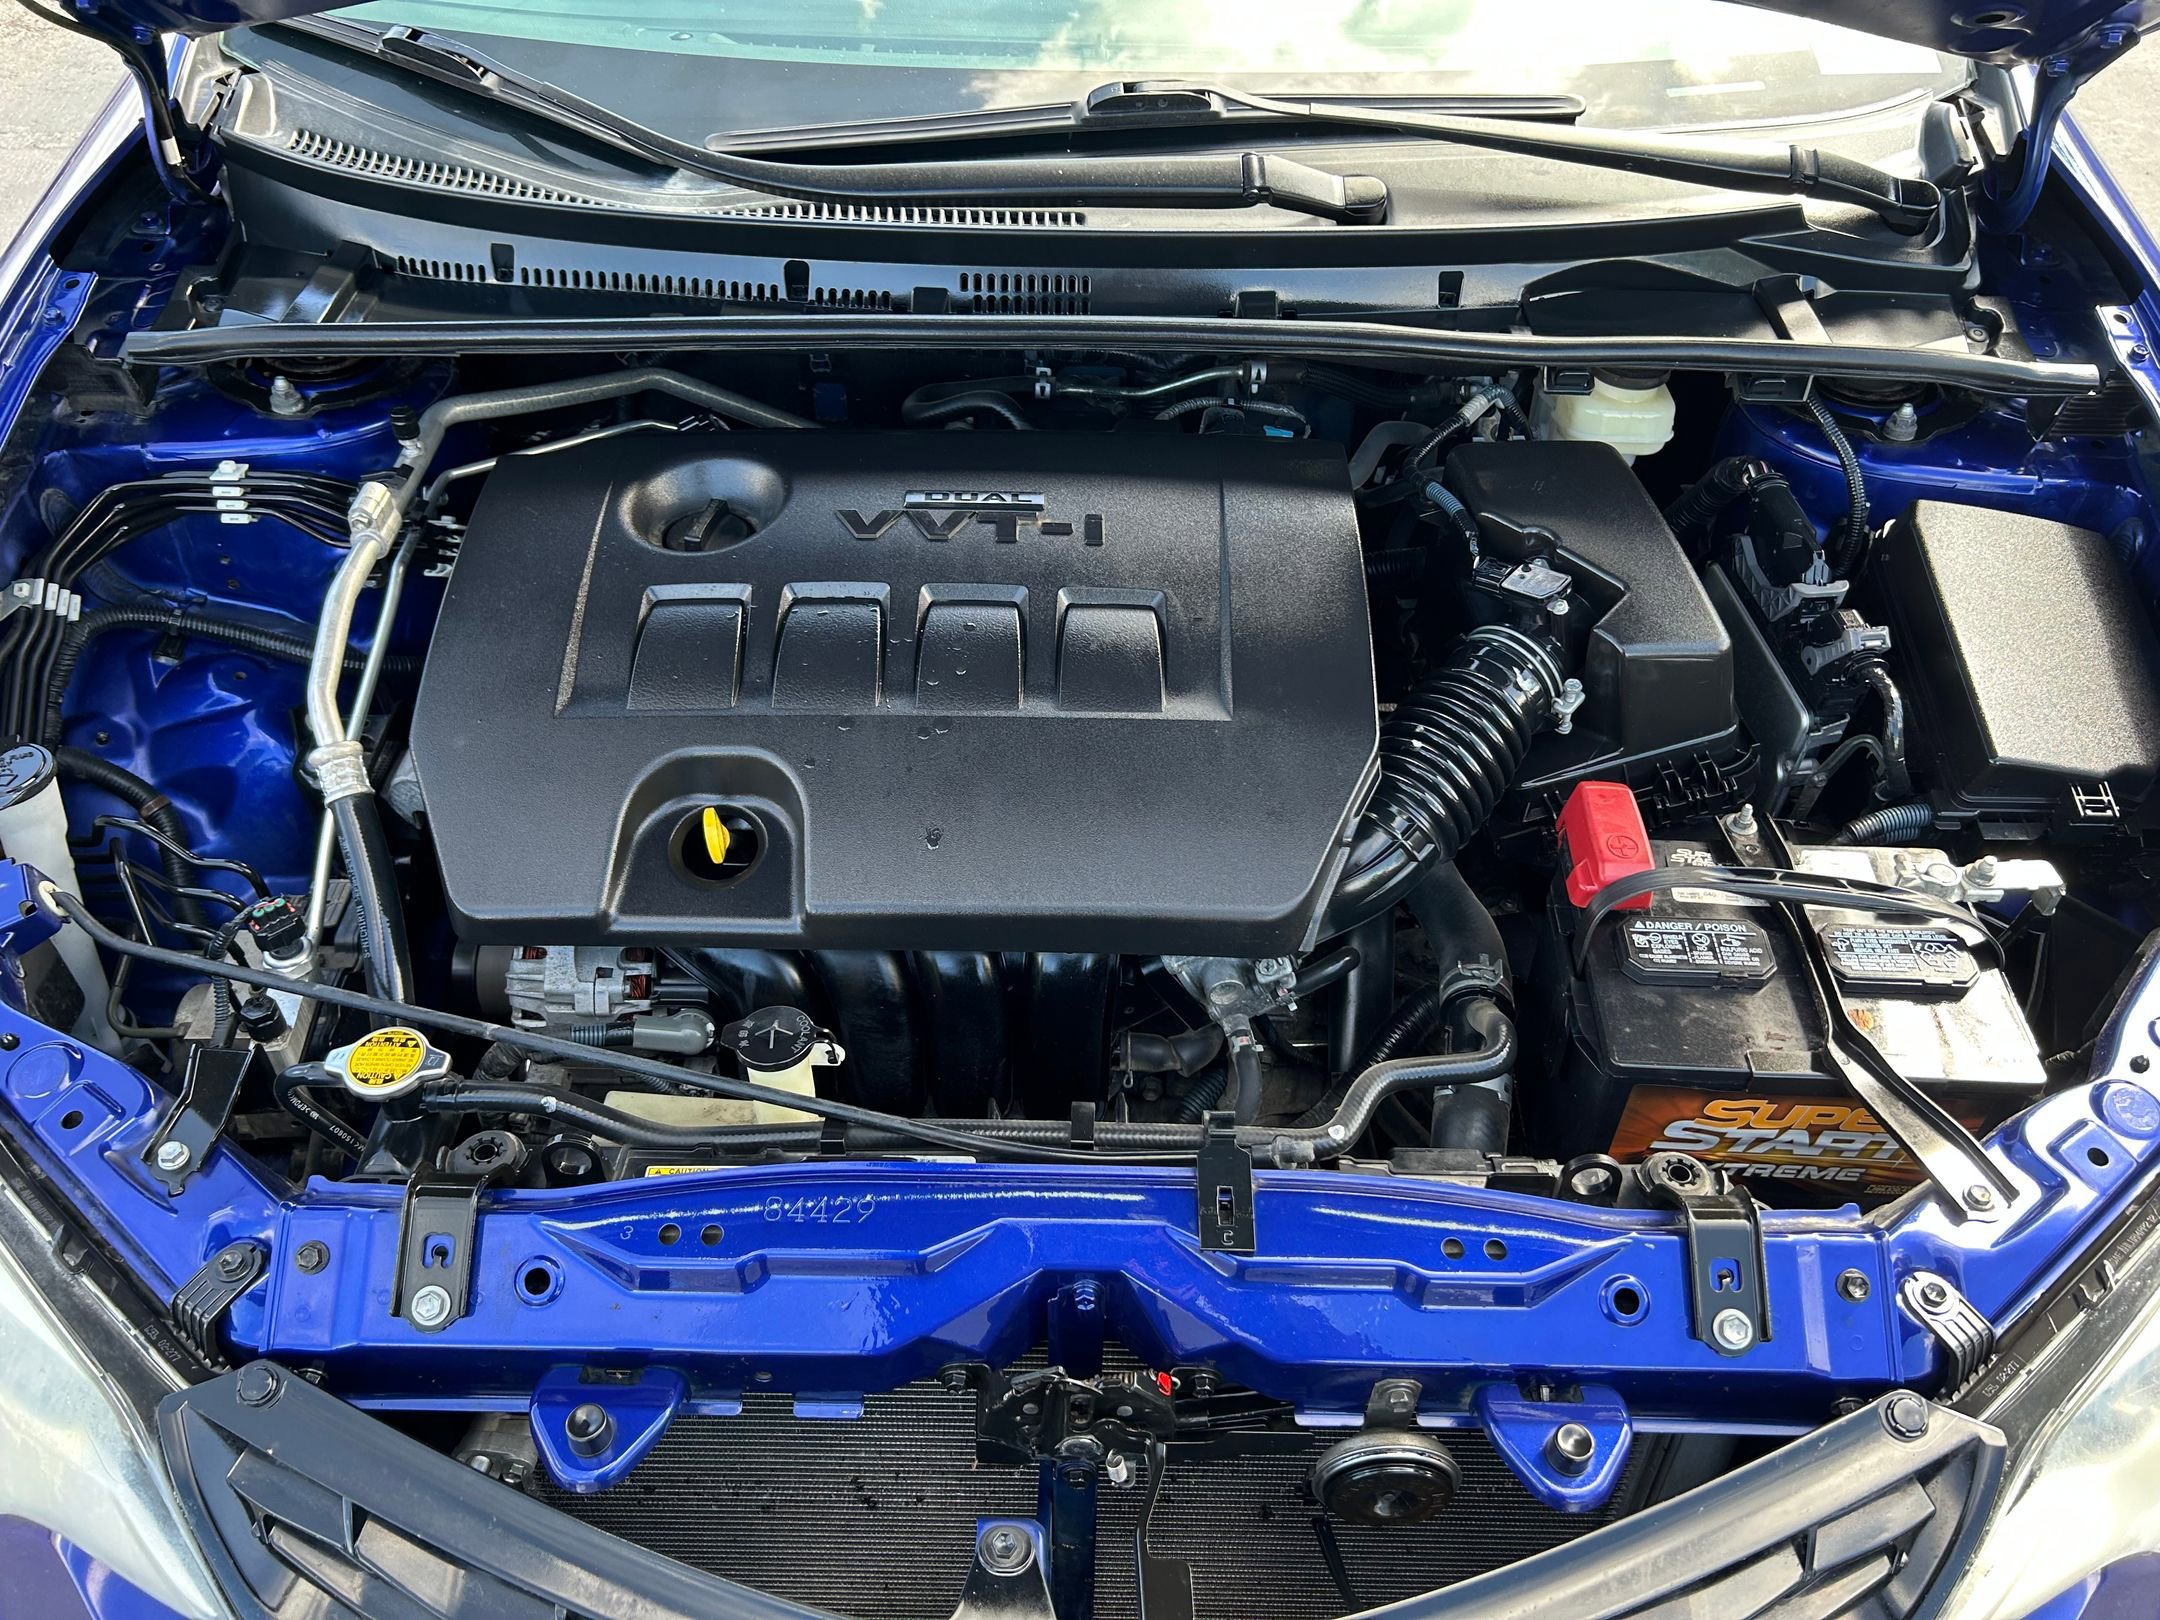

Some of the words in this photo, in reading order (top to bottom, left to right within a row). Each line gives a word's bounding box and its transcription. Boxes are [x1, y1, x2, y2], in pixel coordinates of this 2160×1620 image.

[924, 491, 1033, 503] DUAL
[1645, 921, 1693, 930] DANGER
[1695, 922, 1702, 931] /
[1704, 923, 1747, 933] POISON
[791, 1015, 811, 1054] COOLANT
[356, 1072, 392, 1080] CAUTION
[1693, 1099, 1888, 1132] SUPE
[1704, 1162, 1866, 1182] TREME
[763, 1196, 876, 1224] 84429
